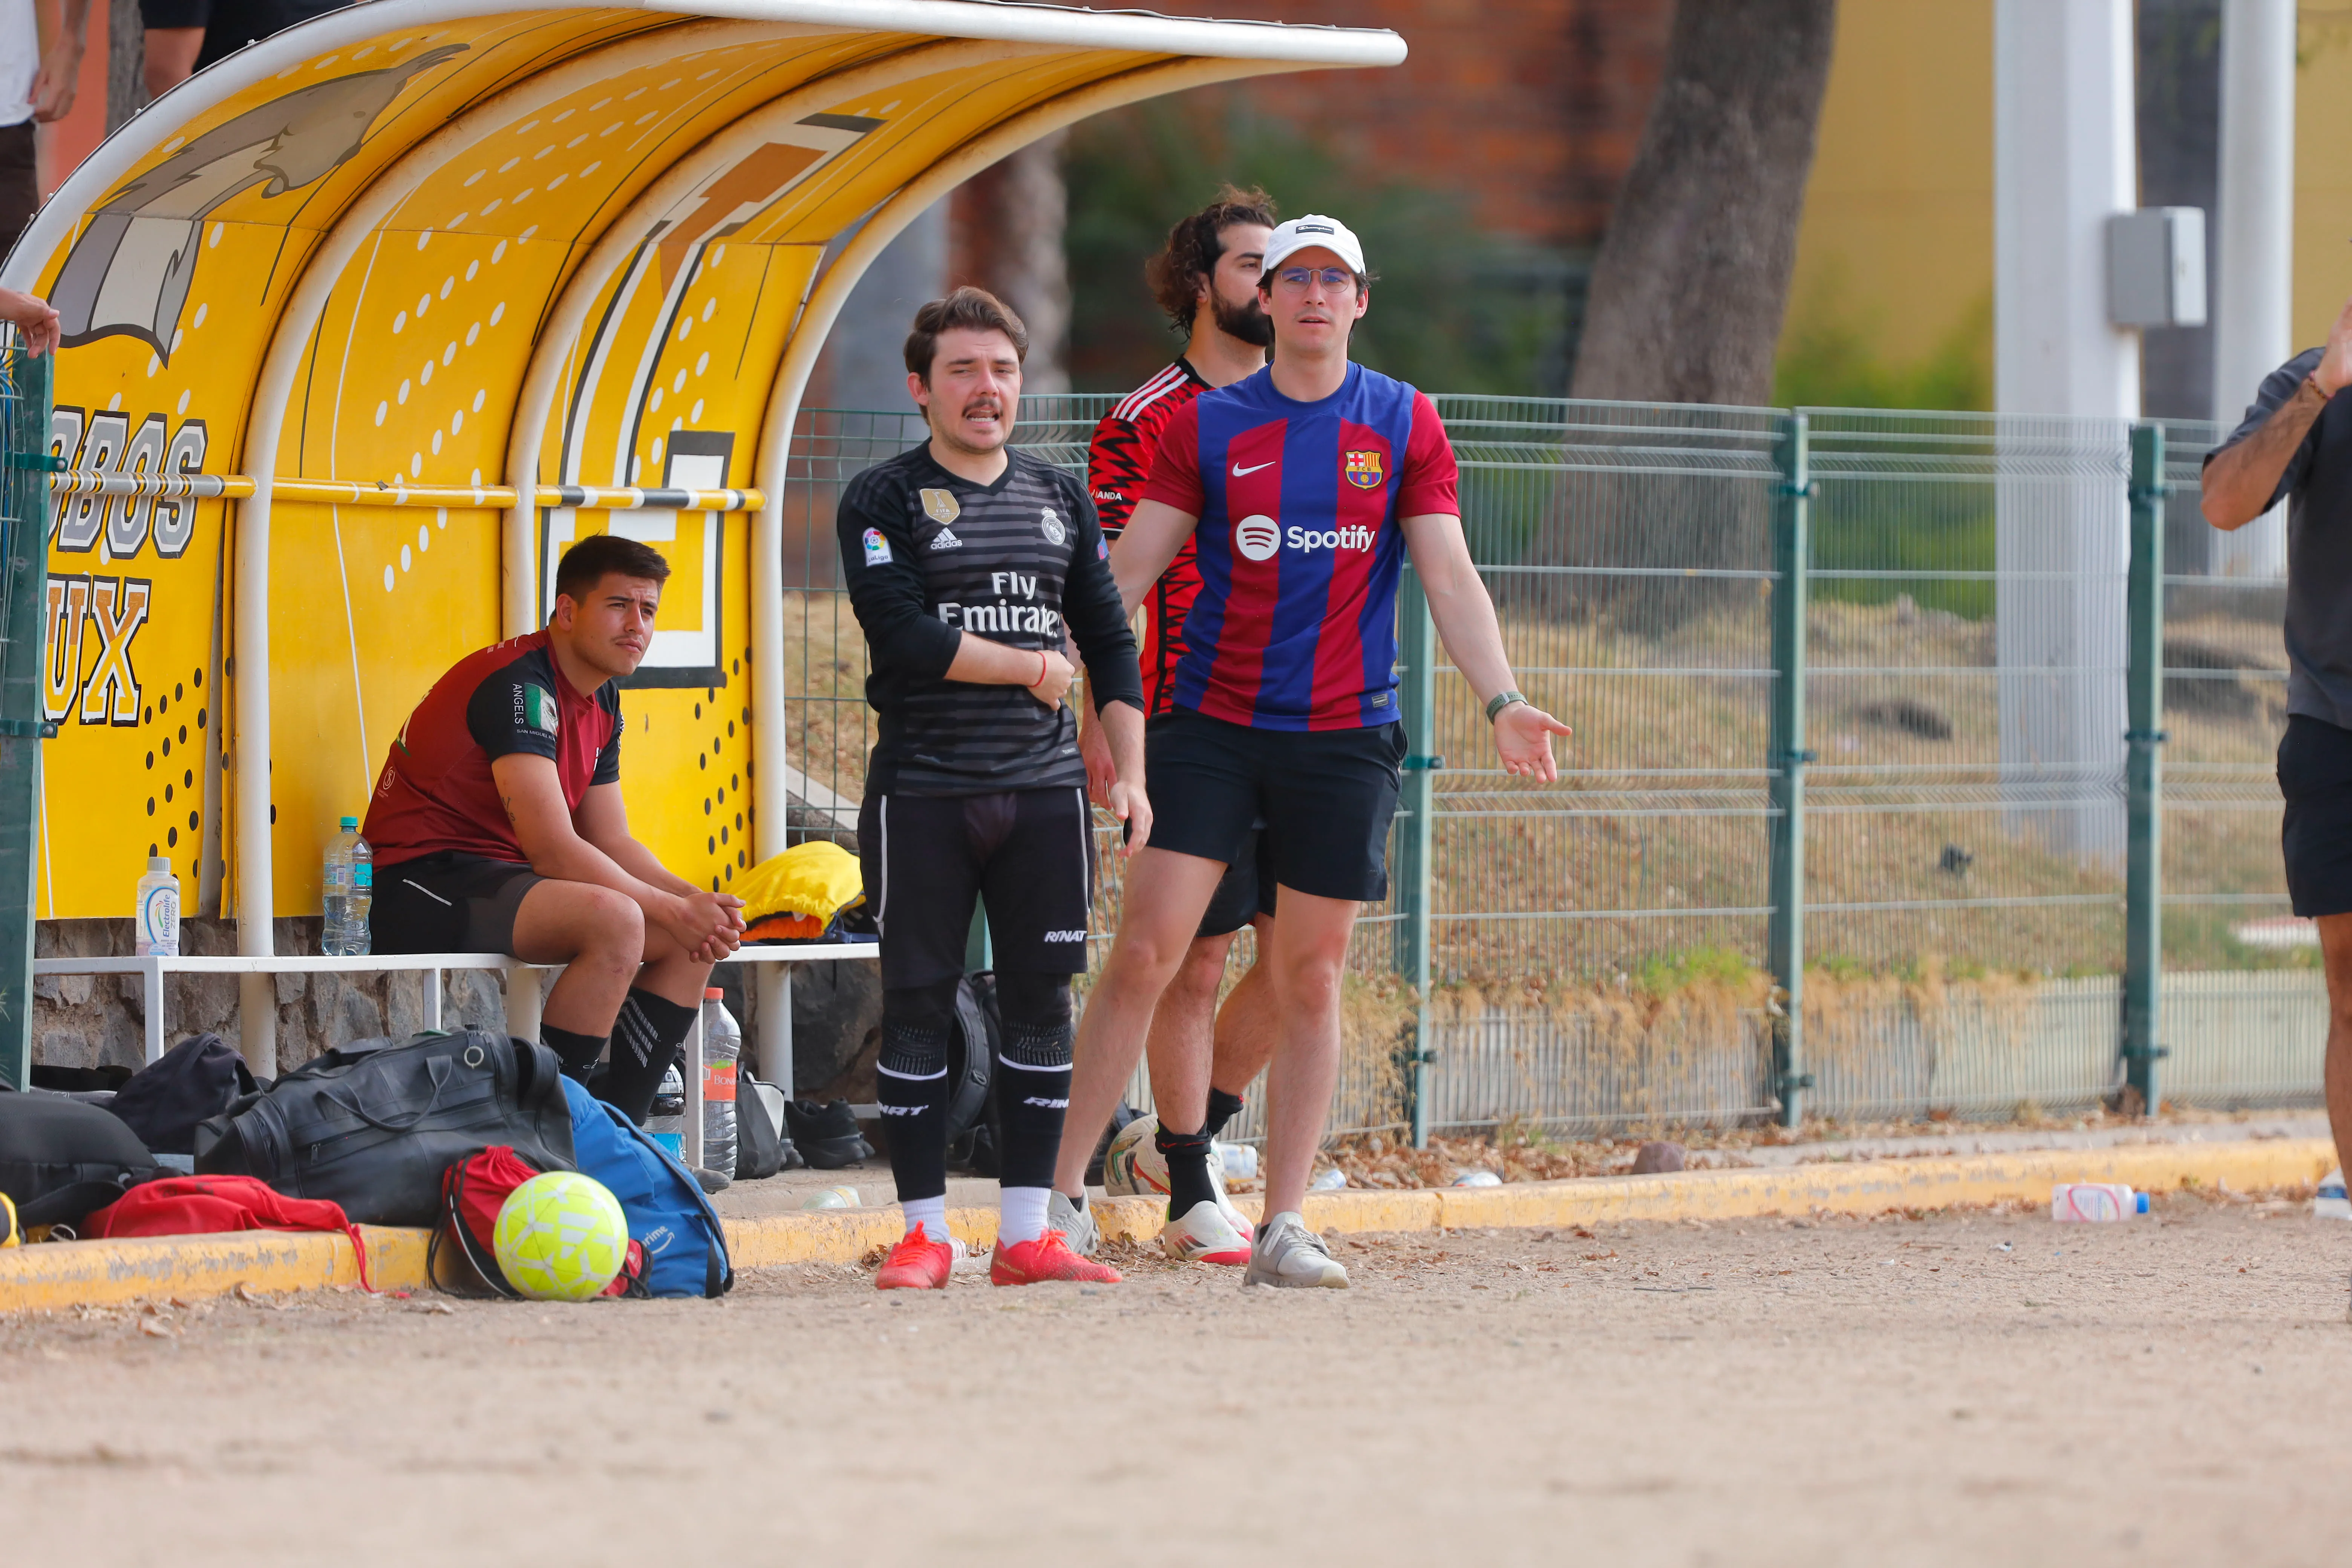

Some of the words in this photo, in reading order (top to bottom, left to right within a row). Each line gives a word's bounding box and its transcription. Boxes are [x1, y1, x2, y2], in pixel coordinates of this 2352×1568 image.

[931, 539, 963, 550] adidas
[1287, 524, 1376, 553] Spotify
[992, 571, 1037, 599] Fly
[513, 683, 524, 724] ANGELS
[1044, 930, 1087, 942] RINAT
[877, 1099, 929, 1116] NAT
